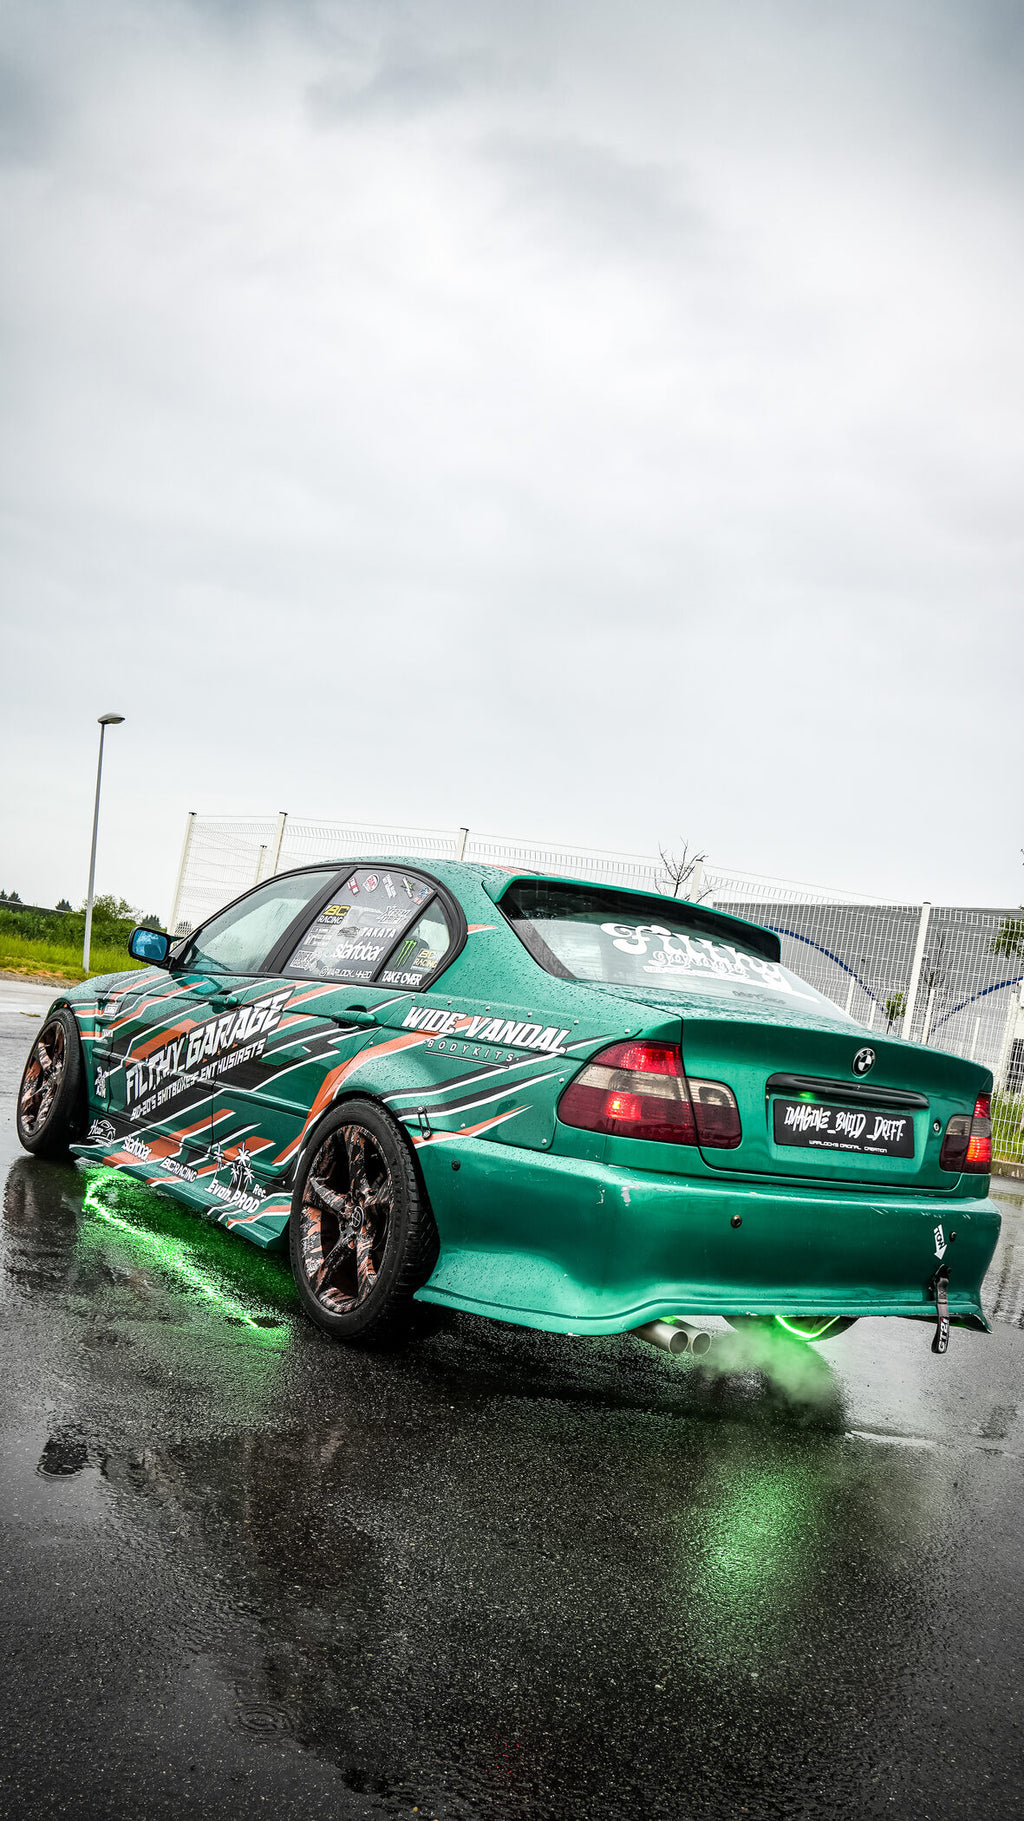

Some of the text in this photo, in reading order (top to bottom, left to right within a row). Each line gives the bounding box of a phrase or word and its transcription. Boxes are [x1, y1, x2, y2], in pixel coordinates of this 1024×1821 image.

[322, 904, 351, 917] BC
[316, 915, 343, 925] RACING
[360, 926, 397, 939] TAKATA
[382, 970, 401, 984] TAKE
[400, 972, 423, 986] OVER
[186, 987, 295, 1071] GARAGE
[400, 1005, 572, 1055] WIDE VANDAL
[199, 1037, 267, 1082] ENTHUSIASTS
